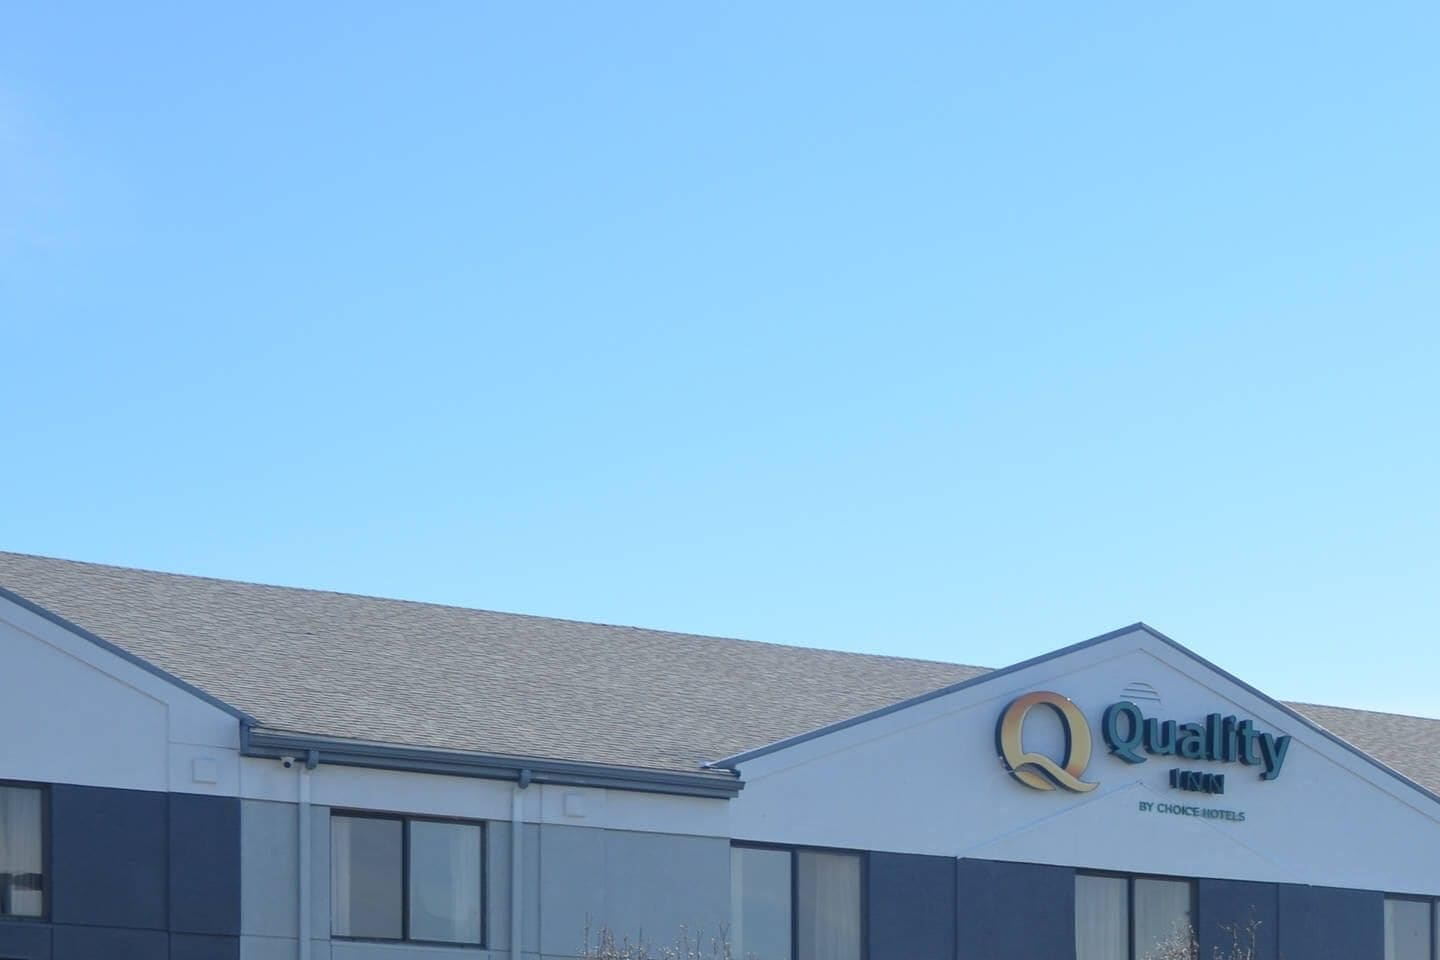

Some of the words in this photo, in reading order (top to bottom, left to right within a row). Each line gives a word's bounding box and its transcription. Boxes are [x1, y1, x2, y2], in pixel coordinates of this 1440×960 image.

[995, 690, 1100, 792] Q
[1102, 701, 1292, 780] Quality
[1169, 768, 1224, 794] INN
[1139, 802, 1154, 812] BY
[1157, 803, 1200, 817] CHOICE
[1202, 808, 1246, 821] HOTELS
